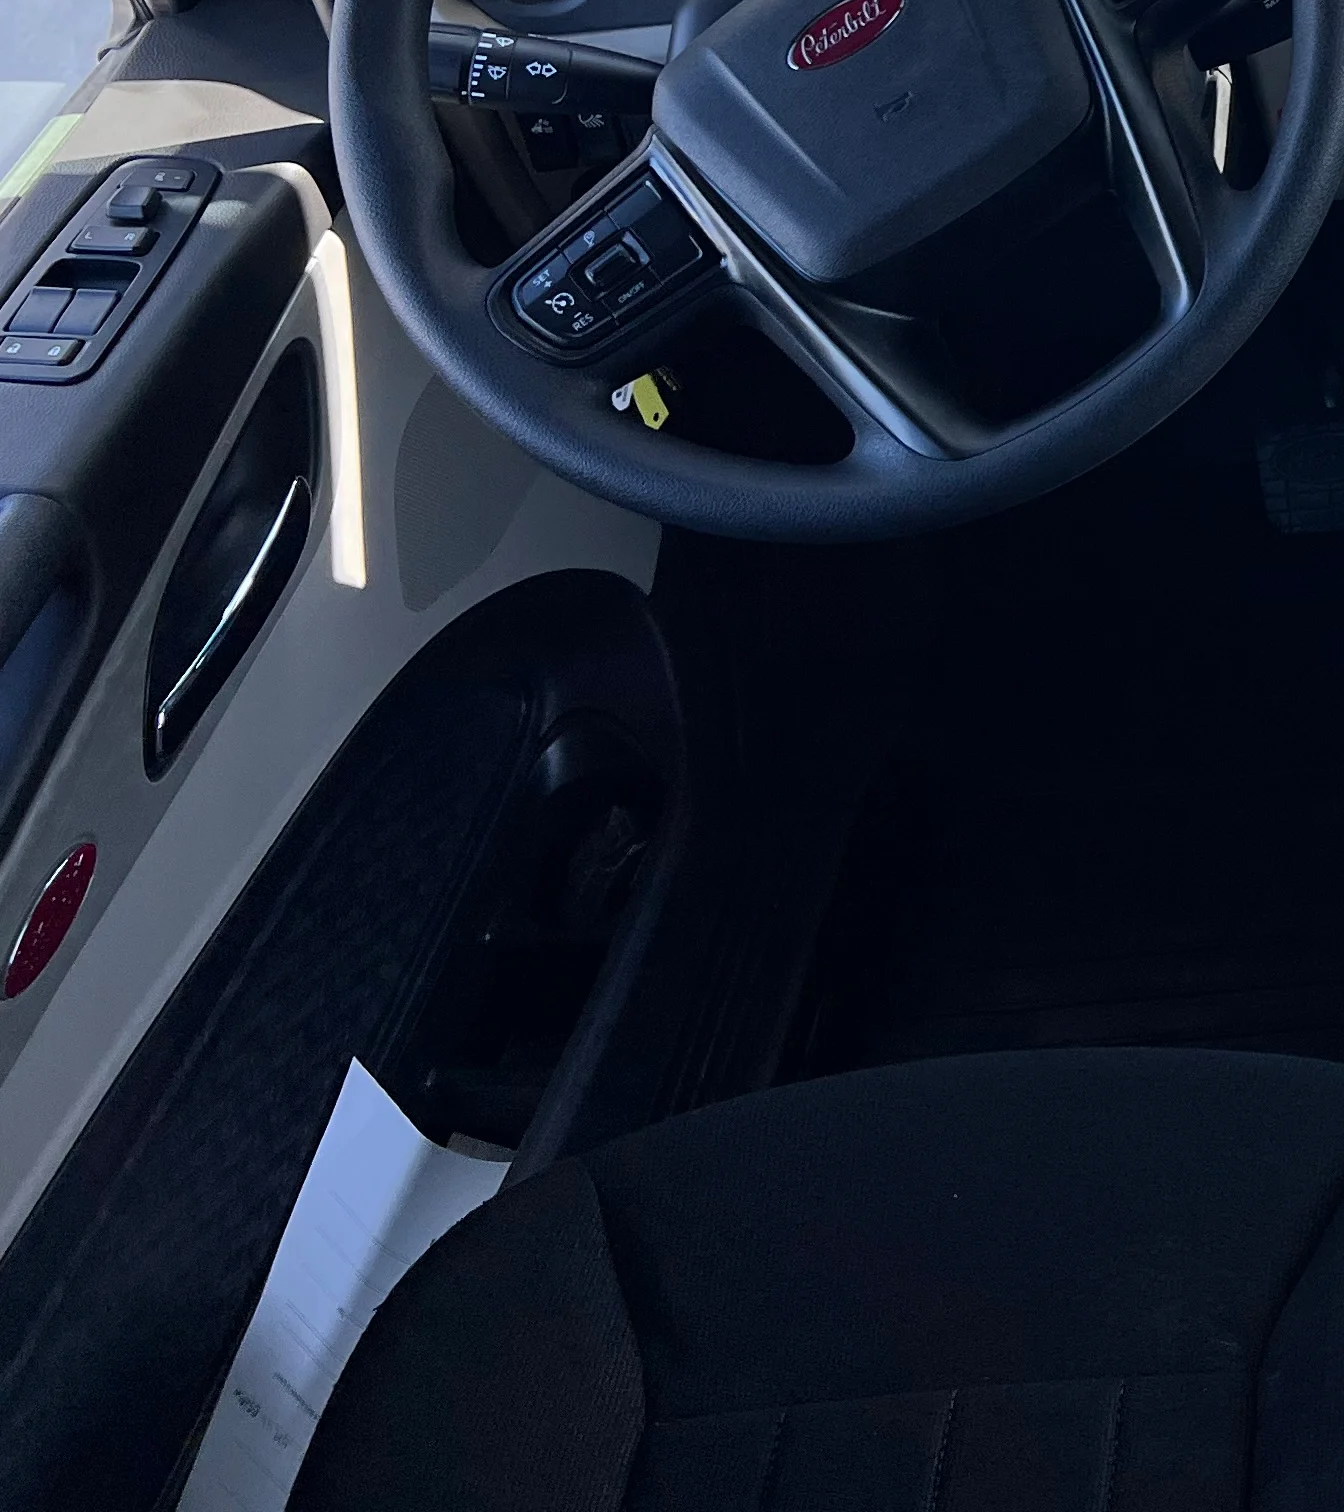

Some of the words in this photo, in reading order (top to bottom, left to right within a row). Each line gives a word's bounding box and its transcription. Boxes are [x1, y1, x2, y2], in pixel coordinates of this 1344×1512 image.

[123, 232, 136, 241] R
[532, 269, 551, 287] SET
[617, 281, 645, 304] ON/OFF
[571, 312, 595, 332] RES
